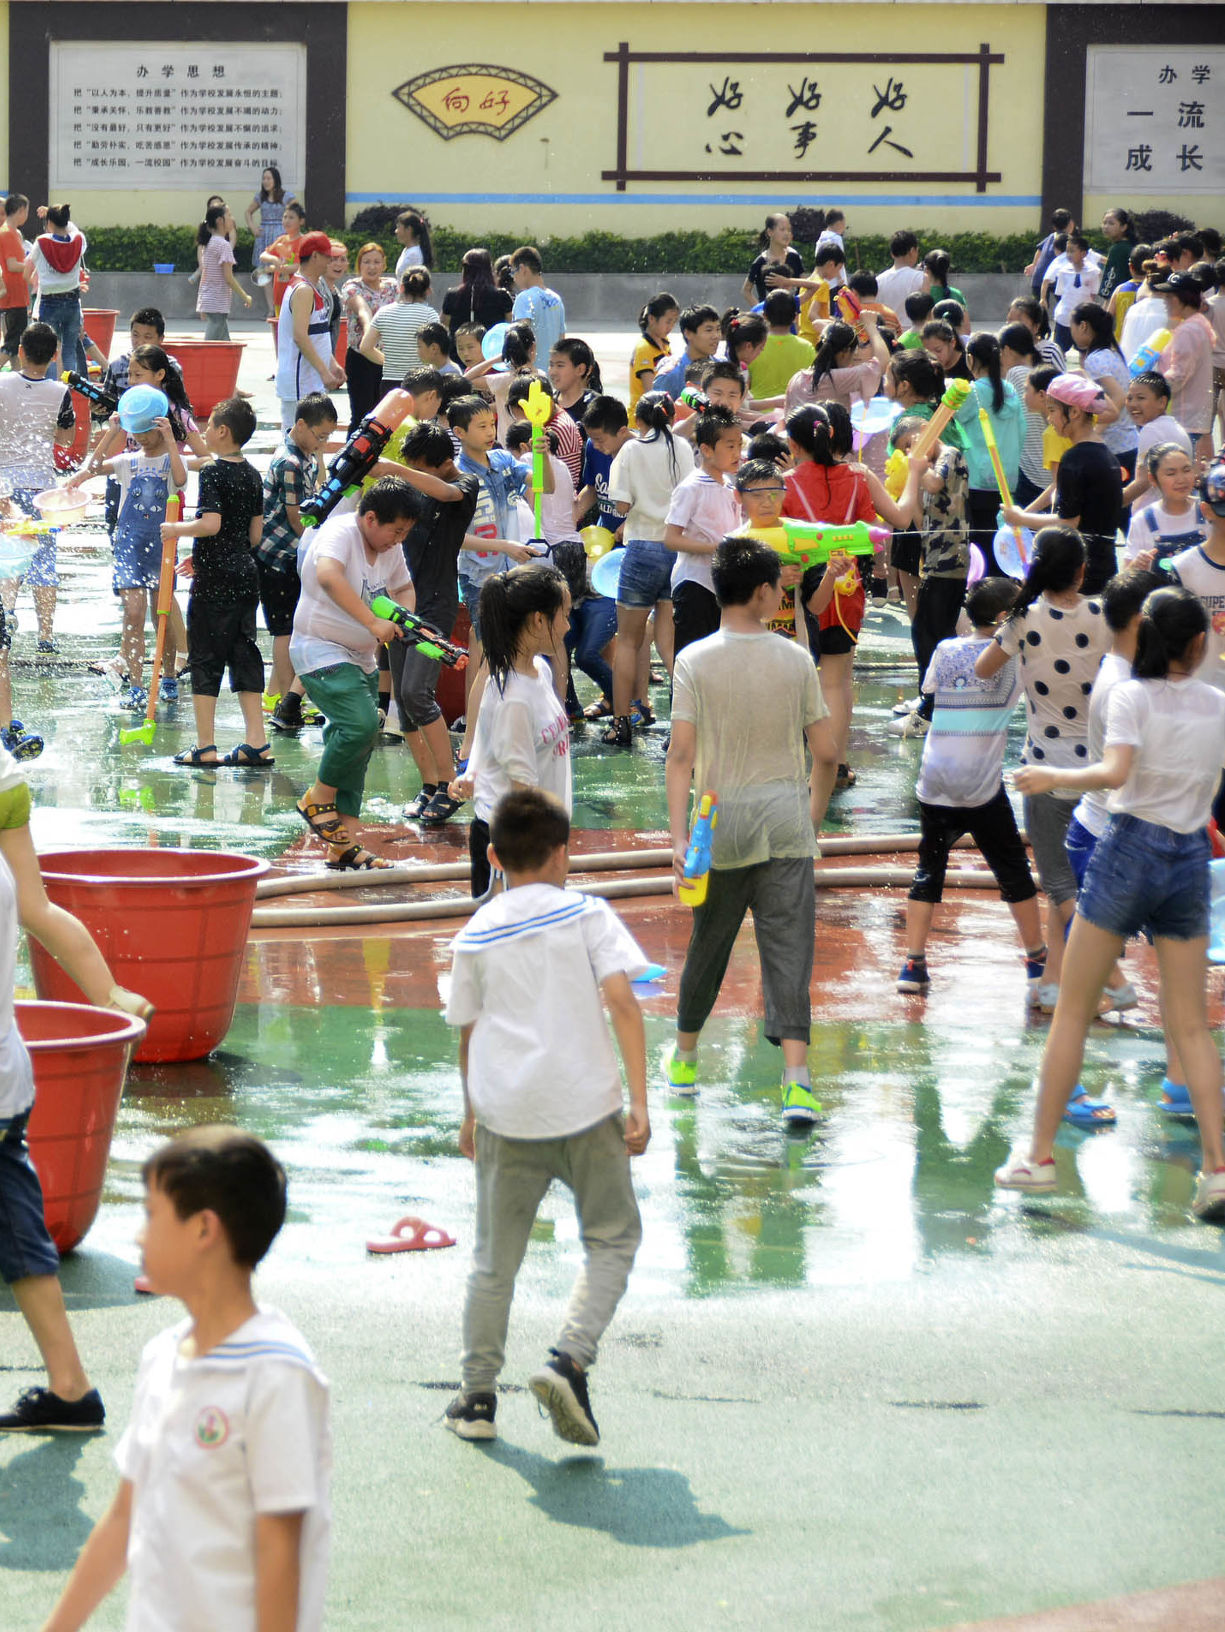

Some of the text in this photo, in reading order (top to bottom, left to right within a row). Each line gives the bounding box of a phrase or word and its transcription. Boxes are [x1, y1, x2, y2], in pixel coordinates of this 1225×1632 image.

[136, 65, 226, 78] 办学思想
[1158, 64, 1211, 85] 办学
[705, 76, 744, 157] 好心
[786, 76, 822, 159] 好事
[868, 76, 914, 159] 好人
[1126, 101, 1206, 129] 一流
[1125, 144, 1204, 172] 成长
